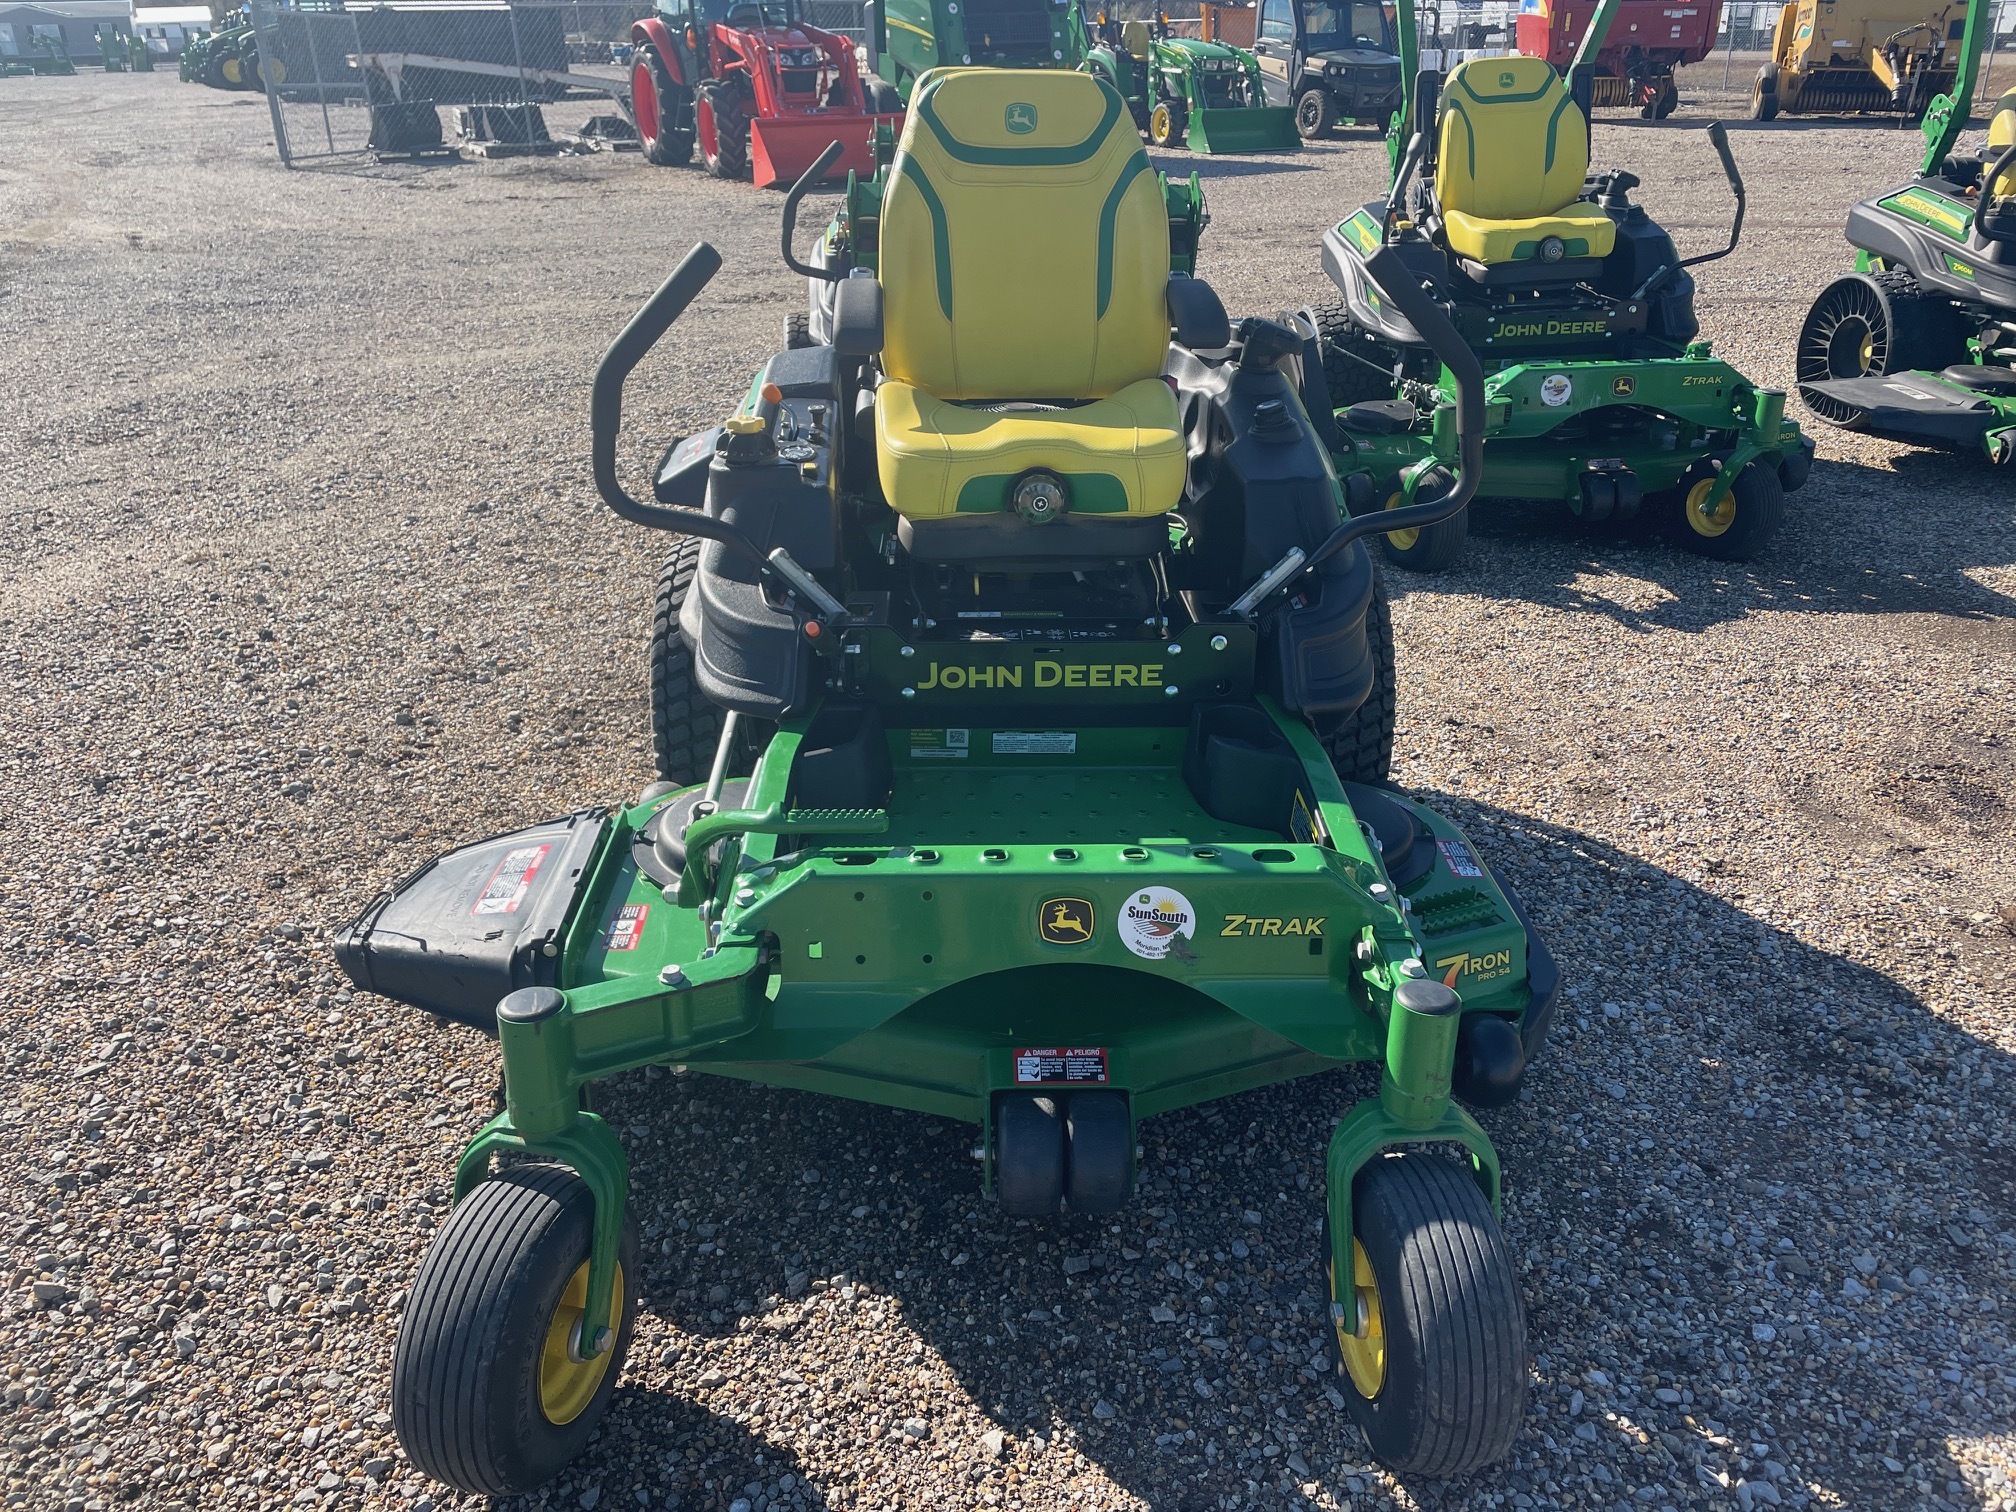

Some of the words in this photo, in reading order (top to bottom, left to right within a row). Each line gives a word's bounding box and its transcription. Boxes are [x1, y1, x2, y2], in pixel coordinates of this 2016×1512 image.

[1494, 323, 1542, 338] JOHN
[1546, 320, 1606, 335] DEERE
[1682, 375, 1723, 386] ZTRAK
[1777, 431, 1796, 441] IRON
[917, 662, 1022, 690] JOHN
[1034, 660, 1164, 688] DEERE
[1127, 905, 1188, 924] SunSouth
[1220, 914, 1327, 937] ZTRAK
[1477, 972, 1496, 982] PRO
[1498, 967, 1511, 978] 54
